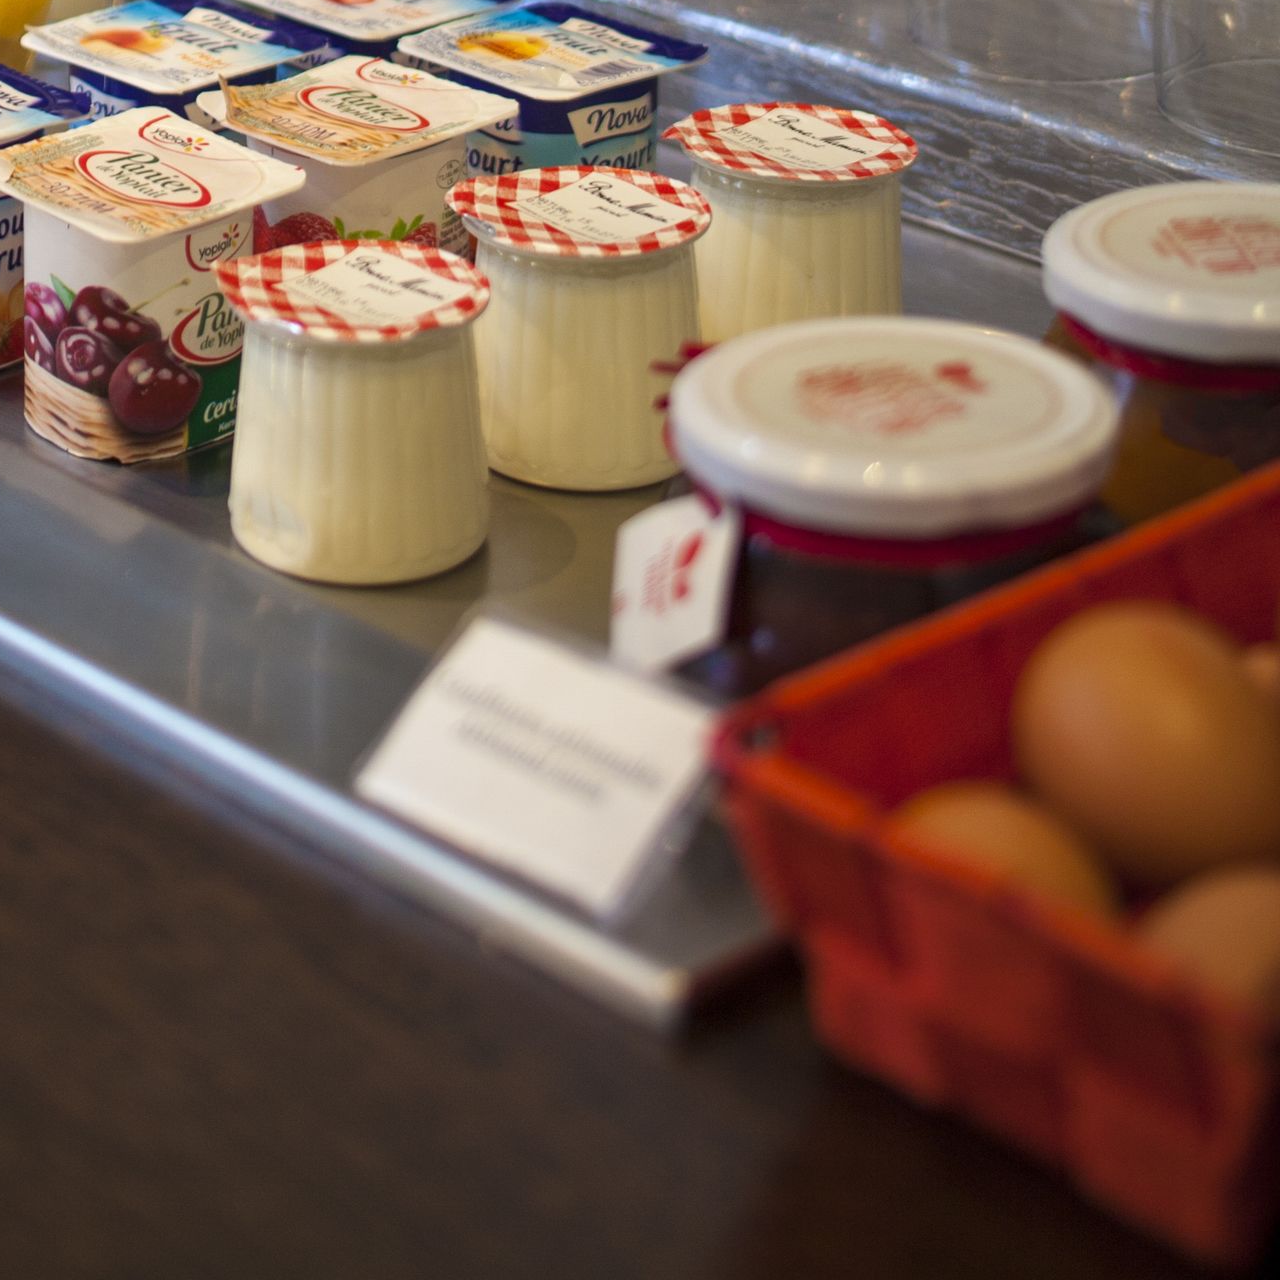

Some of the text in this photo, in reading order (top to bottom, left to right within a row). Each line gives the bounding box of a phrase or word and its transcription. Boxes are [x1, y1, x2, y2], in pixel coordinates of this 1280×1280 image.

[327, 90, 410, 122] Panier
[586, 104, 649, 133] Nova
[106, 149, 194, 195] Panier
[108, 168, 169, 200] Yoplait
[198, 236, 233, 261] yoplait
[200, 320, 245, 351] de Yopl
[203, 389, 236, 423] Ceri
